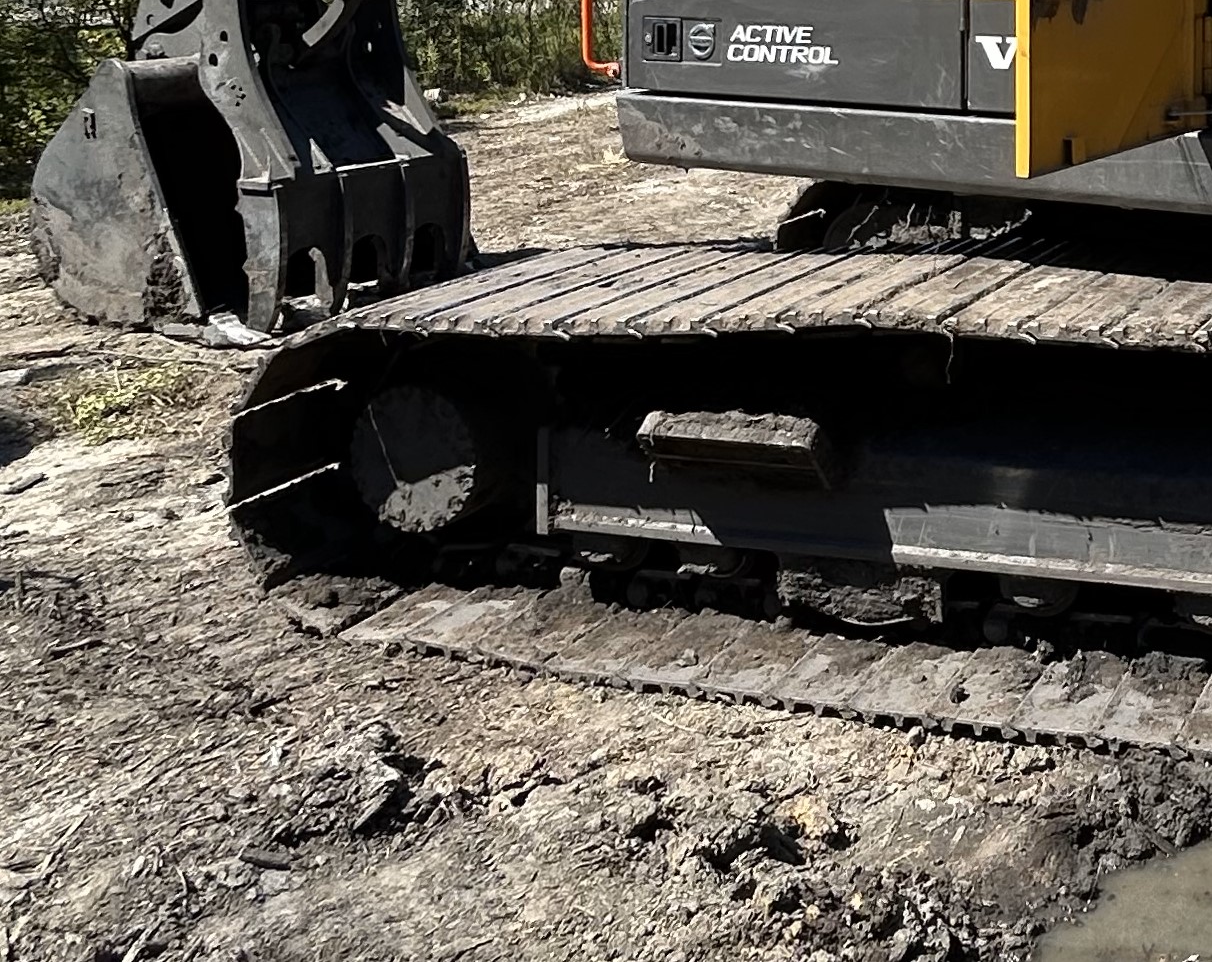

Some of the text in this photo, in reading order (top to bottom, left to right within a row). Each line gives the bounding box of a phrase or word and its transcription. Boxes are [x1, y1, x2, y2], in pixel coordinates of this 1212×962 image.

[729, 24, 814, 44] ACTIVE
[727, 44, 839, 65] CONTROL
[975, 35, 1017, 69] V
